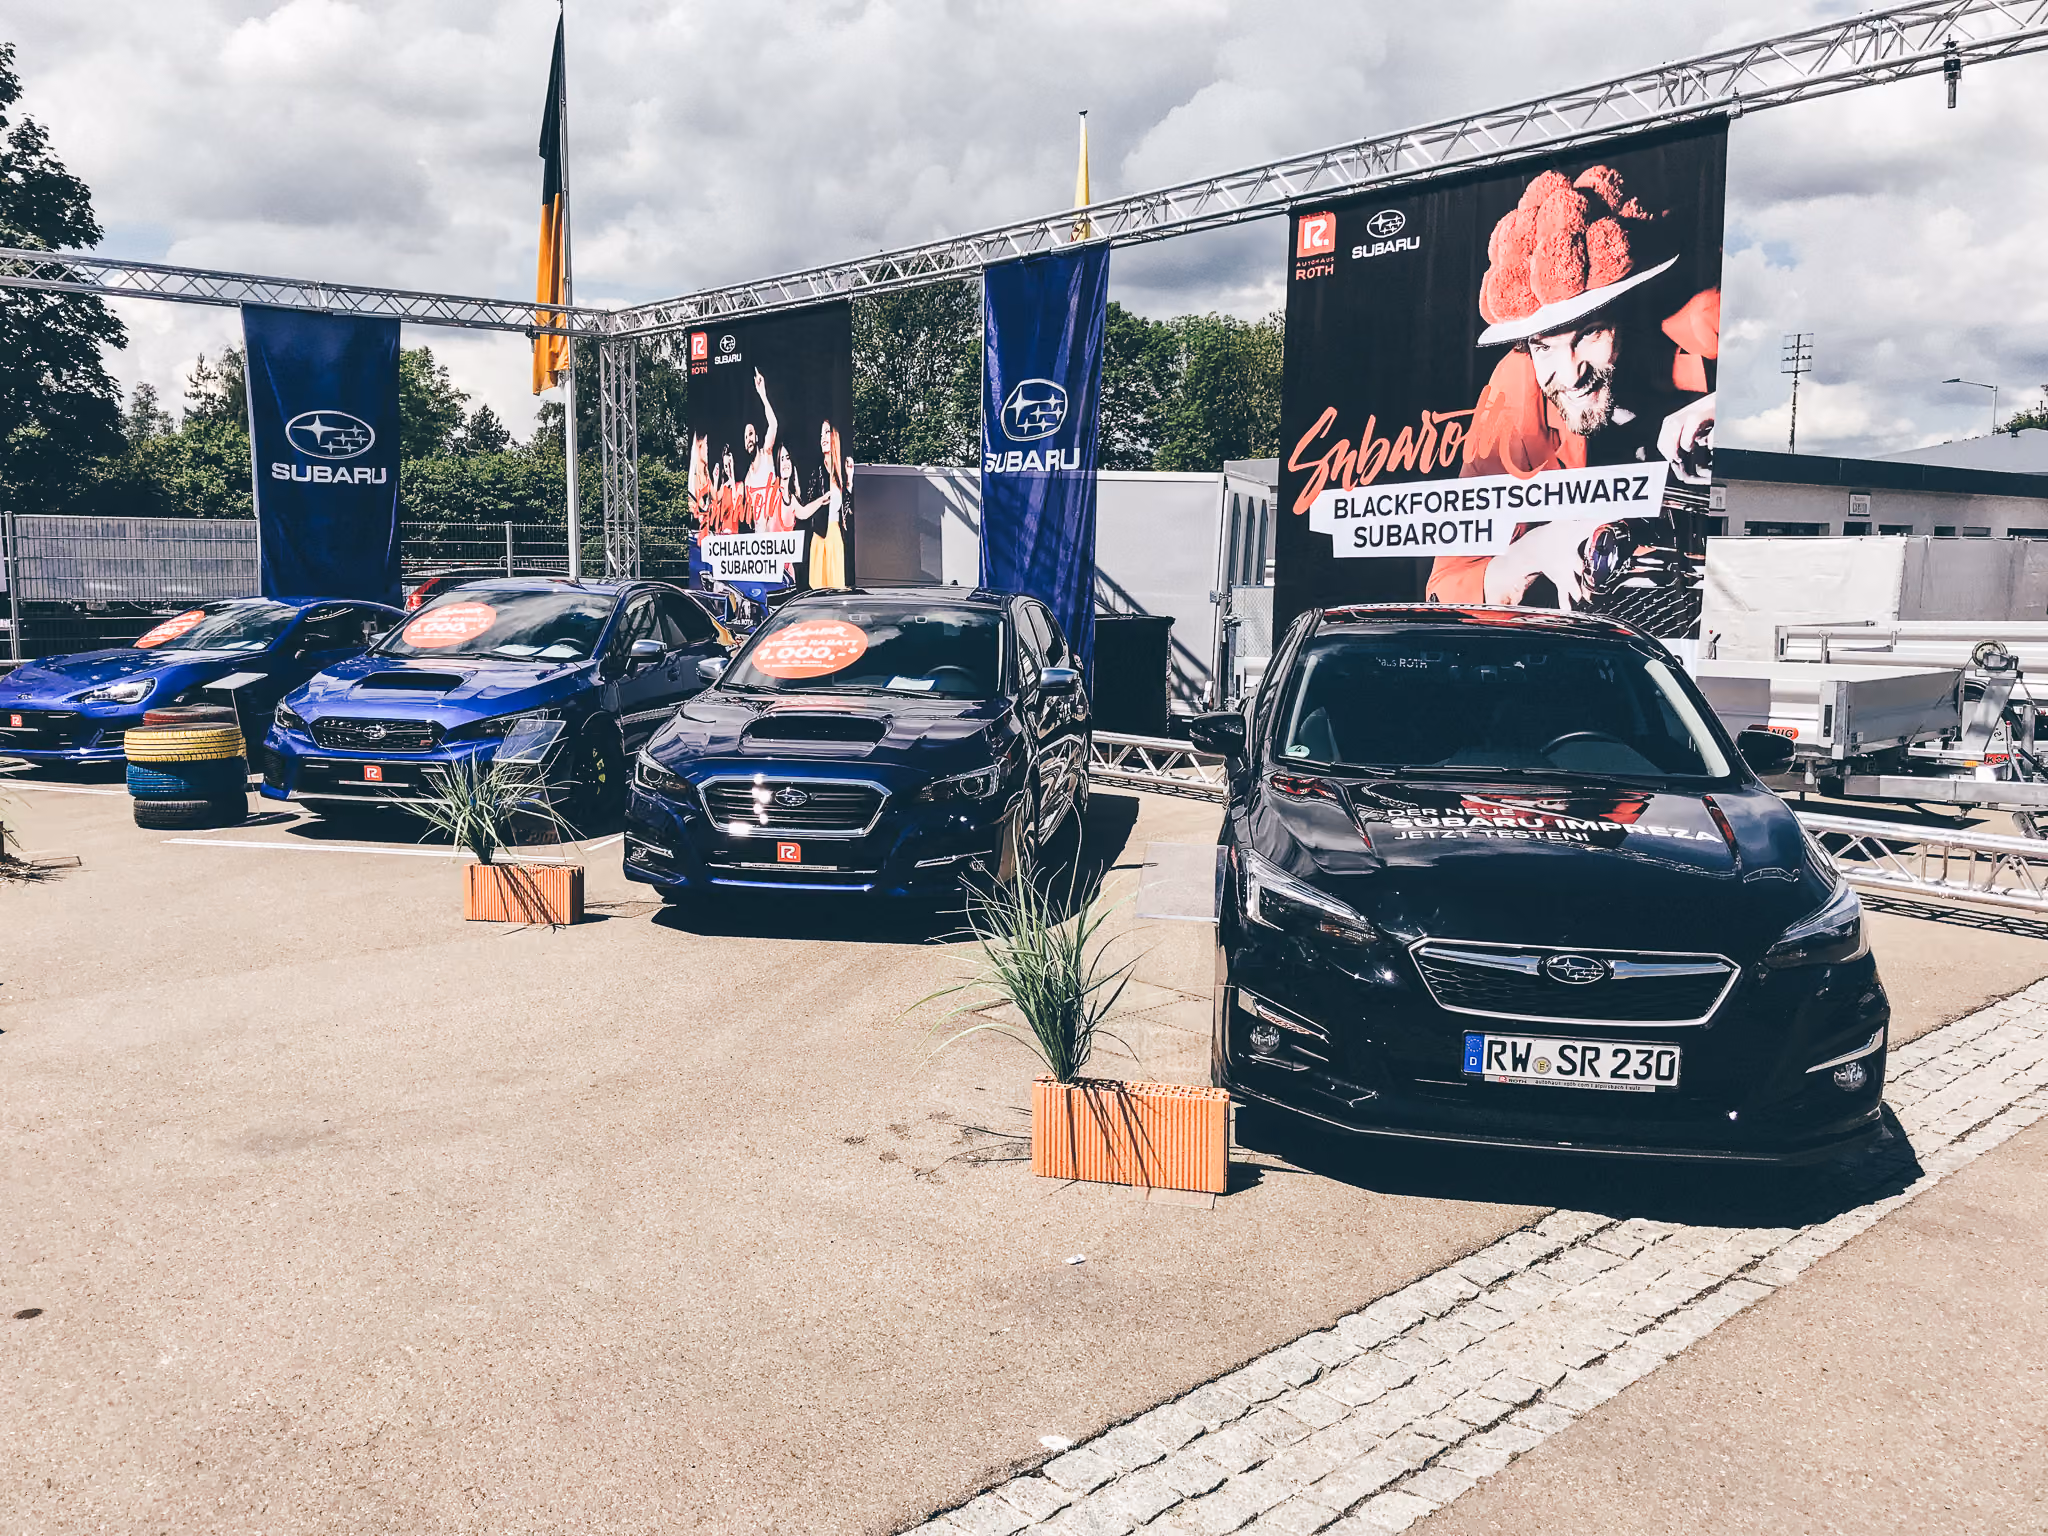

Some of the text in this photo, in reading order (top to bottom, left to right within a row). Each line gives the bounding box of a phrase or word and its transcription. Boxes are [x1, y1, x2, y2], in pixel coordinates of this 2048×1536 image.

[1351, 236, 1420, 259] SUBARU
[1296, 256, 1334, 267] AUTOHAUS
[1296, 264, 1334, 280] ROTH
[714, 353, 742, 365] SUBARU
[984, 447, 1080, 473] SUBARU
[271, 462, 387, 484] SUBARU
[1334, 476, 1649, 519] BLACKFORESTSCHWARZ
[1353, 519, 1493, 548] SUBAROTH
[720, 560, 777, 574] SUBAROTH
[1387, 808, 1515, 816] DER NEUE
[1390, 817, 1723, 843] SUBARU IMPREZA
[1394, 829, 1590, 842] JETZT TESTEN!
[1469, 1039, 1676, 1081] D RW SR 230
